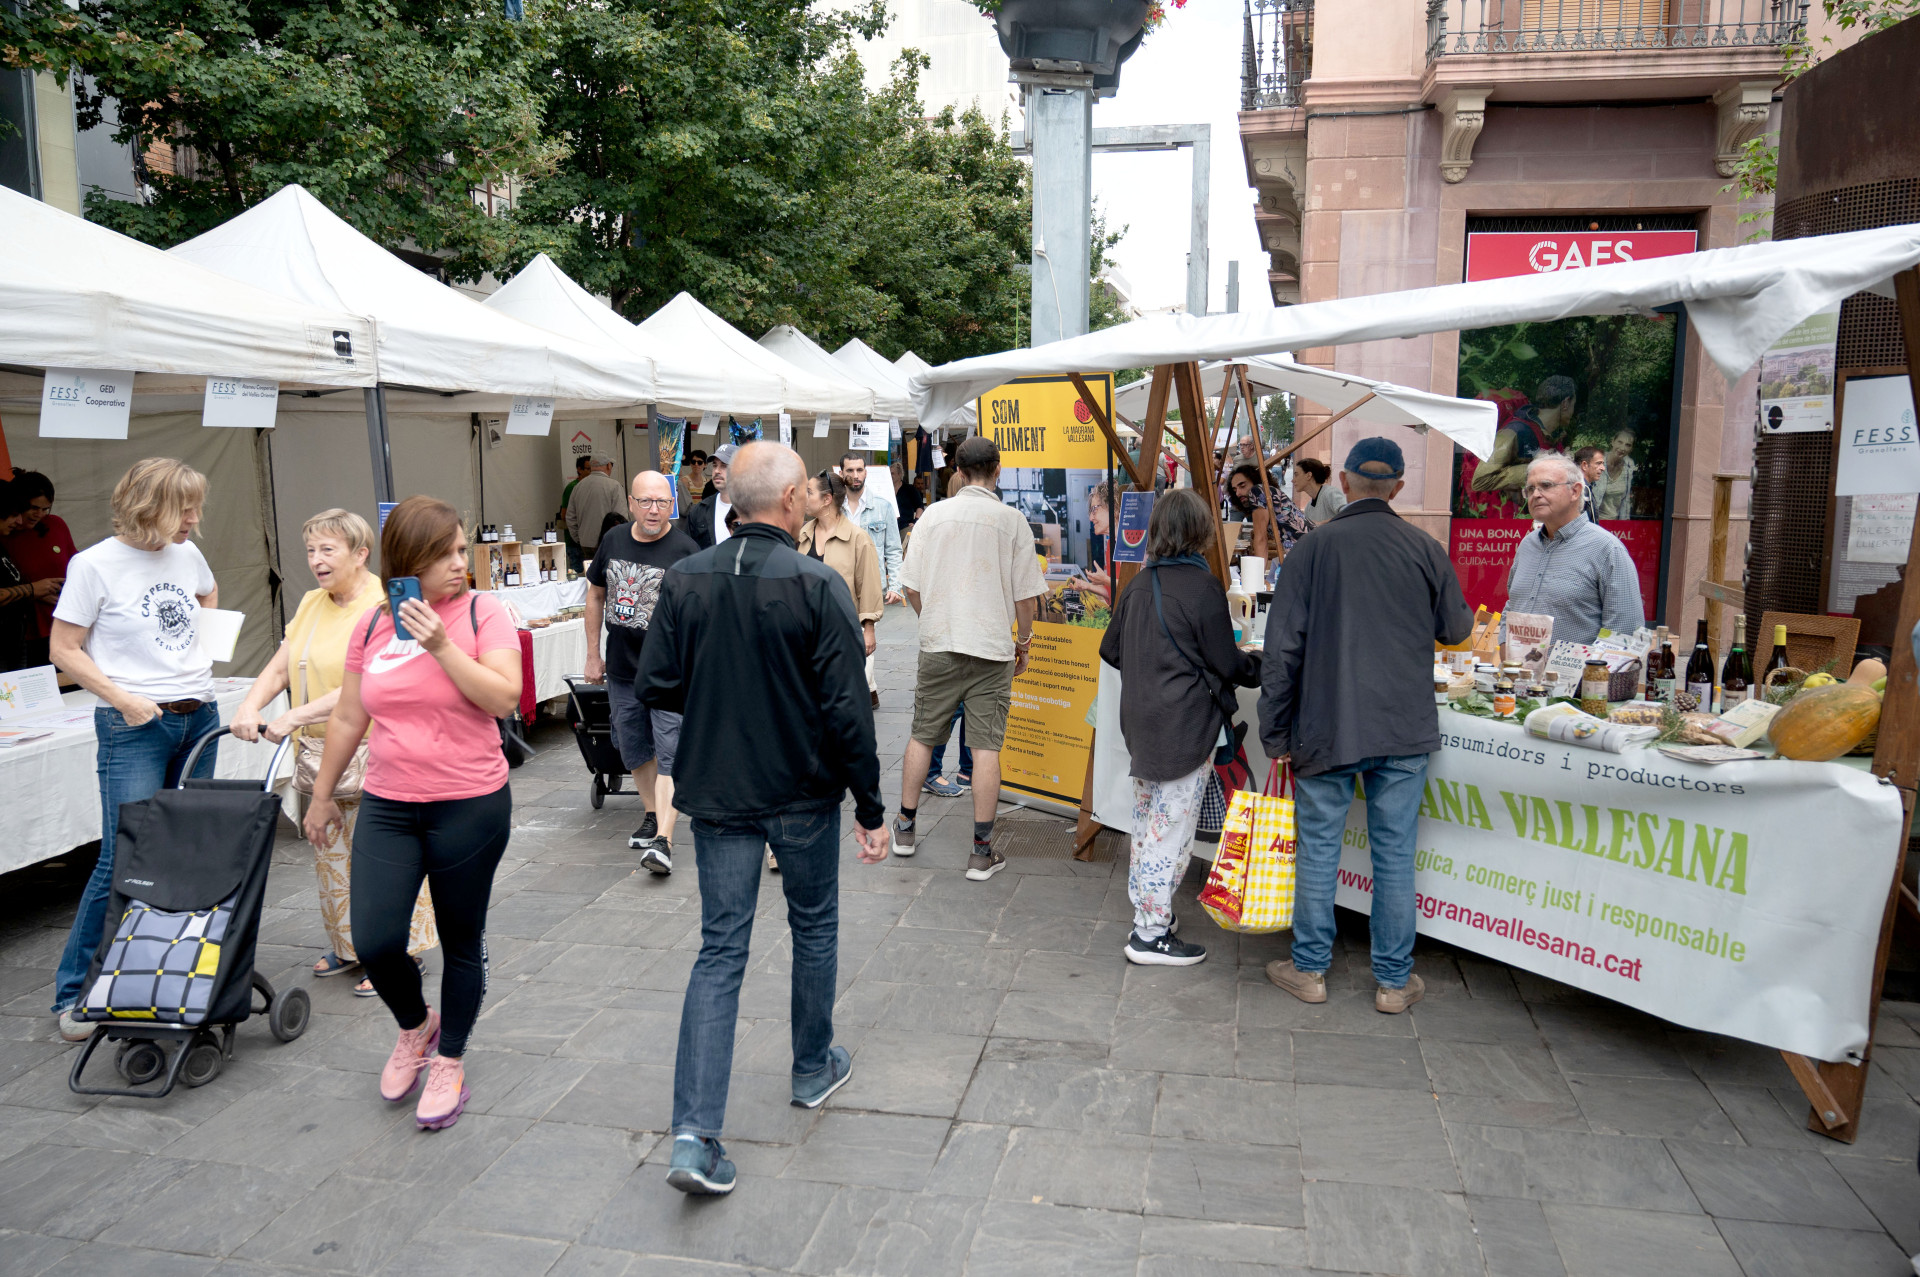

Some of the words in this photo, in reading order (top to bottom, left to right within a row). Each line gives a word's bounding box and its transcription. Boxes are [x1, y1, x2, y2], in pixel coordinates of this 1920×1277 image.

[49, 386, 79, 399] FESS
[99, 384, 116, 394] GEDI
[212, 382, 237, 394] FESS
[85, 396, 126, 407] Cooperativa
[992, 399, 1020, 424] SOM
[1062, 426, 1069, 435] LA
[1070, 426, 1095, 435] MAGRANA
[1853, 426, 1912, 444] FESS
[994, 426, 1046, 452] ALIMENT
[1067, 434, 1096, 443] VALLESANA
[572, 443, 592, 454] sostre
[1858, 446, 1907, 454] Granollers
[1459, 528, 1484, 539] UNA
[1487, 528, 1521, 539] BONA
[1458, 542, 1473, 552] DE
[1476, 542, 1513, 552] SALUT
[1458, 556, 1504, 566] CUIDA-LA
[150, 583, 195, 611] PERSONA
[615, 604, 635, 616] TIKI
[1043, 635, 1072, 644] saludables
[1030, 642, 1057, 651] proximitat
[1034, 655, 1050, 663] justos
[1053, 658, 1070, 666] tracte
[1071, 660, 1090, 669] honest
[1550, 660, 1583, 670] OBLIDADES
[1556, 655, 1582, 664] PLANTES
[1027, 667, 1053, 676] producció
[1084, 675, 1097, 683] local
[1014, 677, 1039, 686] comunitat
[1043, 682, 1060, 690] suport
[1009, 700, 1040, 710] operativa
[1018, 691, 1024, 699] la
[1025, 692, 1038, 701] teva
[1039, 696, 1071, 708] ecobotiga
[1439, 733, 1545, 765] nsumidors
[1561, 752, 1572, 771] i
[1587, 761, 1746, 795] productors
[1499, 790, 1749, 895] VALLESANA
[1465, 863, 1537, 906] comerç
[1541, 881, 1582, 914] just
[1587, 893, 1595, 917] i
[1600, 901, 1746, 963] responsable
